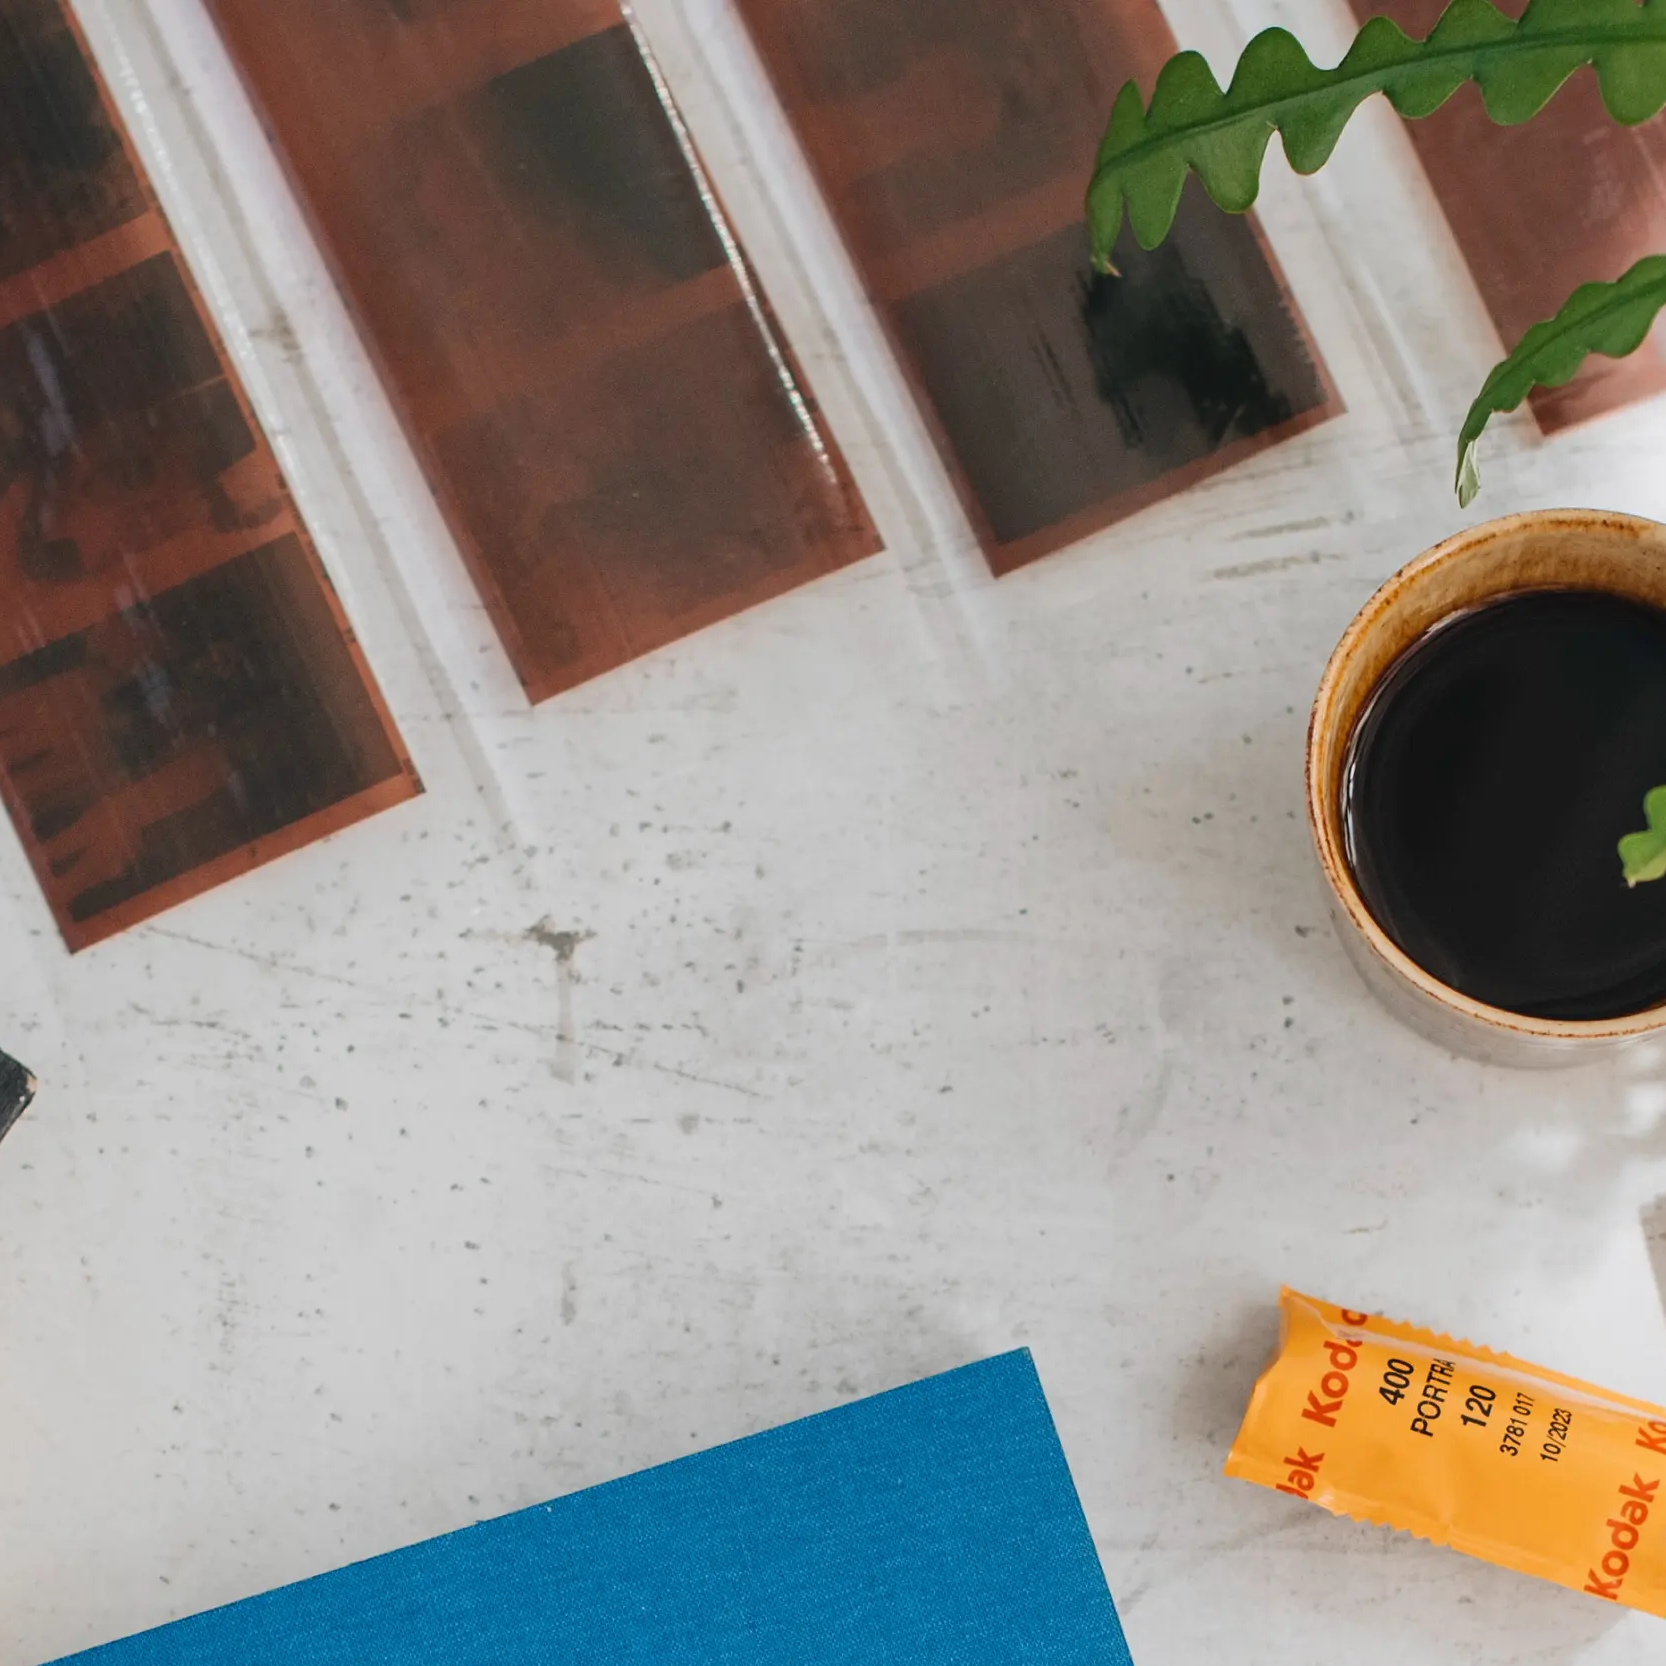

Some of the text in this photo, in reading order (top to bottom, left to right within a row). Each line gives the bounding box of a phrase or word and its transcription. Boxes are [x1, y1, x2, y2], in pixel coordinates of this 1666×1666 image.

[1379, 1357, 1415, 1406] 400
[1410, 1357, 1457, 1437] PORTRA
[1460, 1384, 1497, 1427] 120
[1499, 1391, 1536, 1457] 3781 017
[1540, 1407, 1573, 1462] 10/2023
[1583, 1472, 1661, 1600] Kodak
